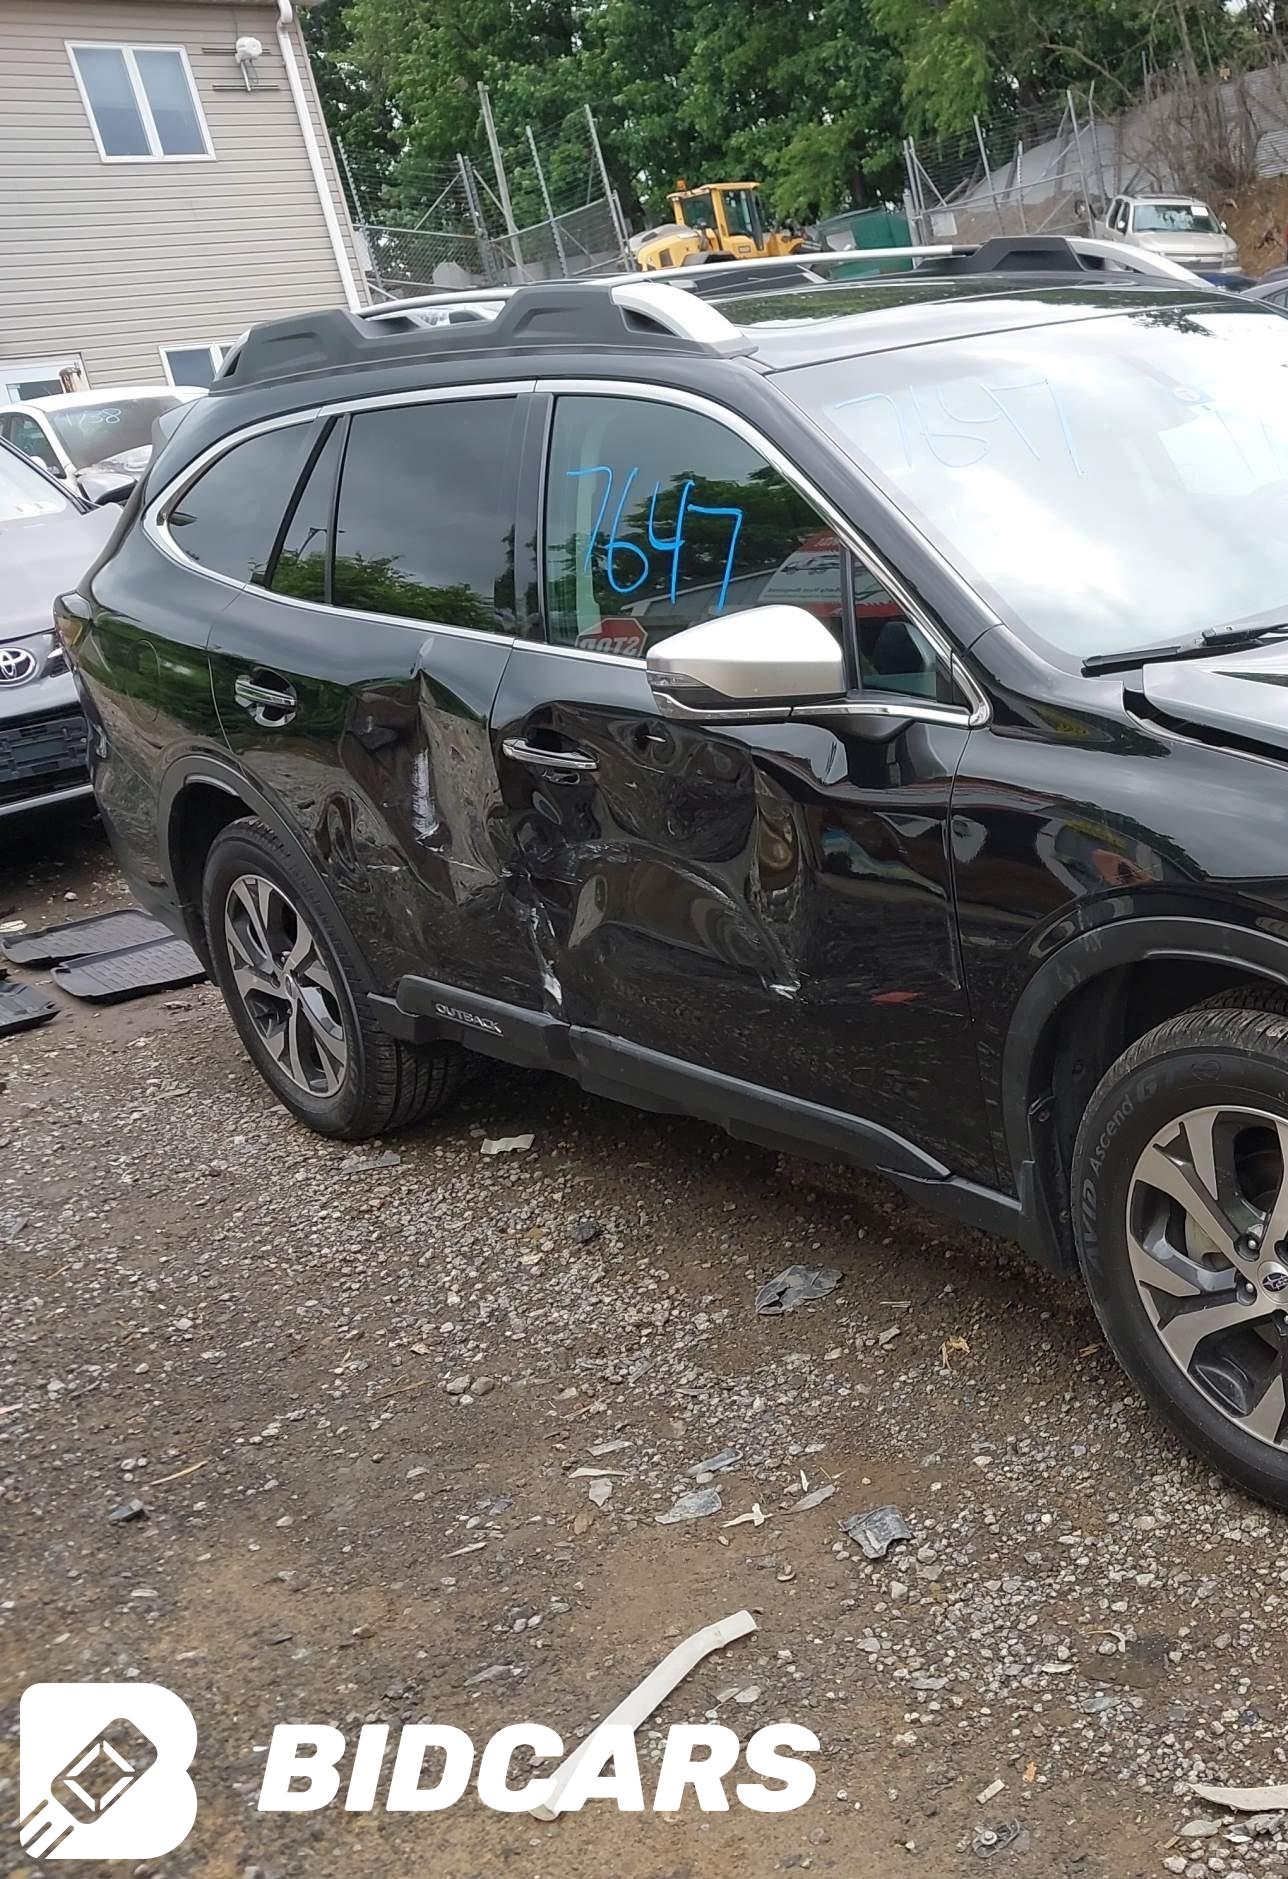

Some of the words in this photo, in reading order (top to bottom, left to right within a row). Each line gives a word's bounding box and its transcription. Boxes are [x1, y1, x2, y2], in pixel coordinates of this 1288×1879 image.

[565, 465, 744, 614] 7647
[434, 1002, 503, 1034] OUTBACK
[1088, 1094, 1135, 1178] Ascend
